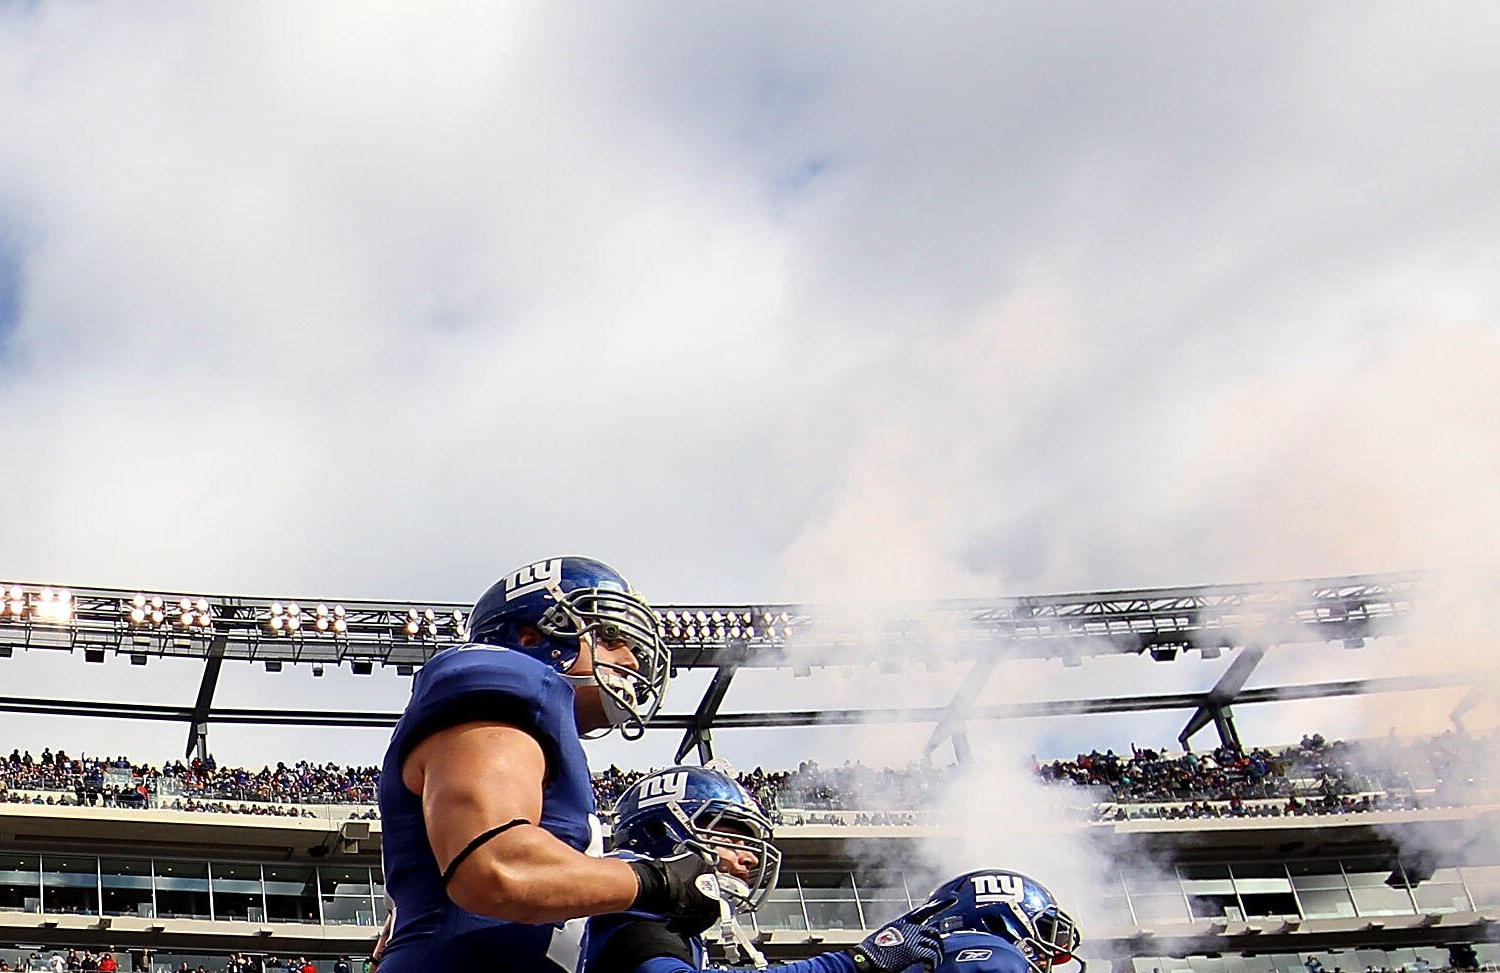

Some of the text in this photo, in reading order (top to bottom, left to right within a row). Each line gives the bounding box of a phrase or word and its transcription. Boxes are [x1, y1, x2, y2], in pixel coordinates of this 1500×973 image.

[503, 557, 563, 602] ny
[638, 770, 689, 810] ny
[970, 874, 1025, 904] ny
